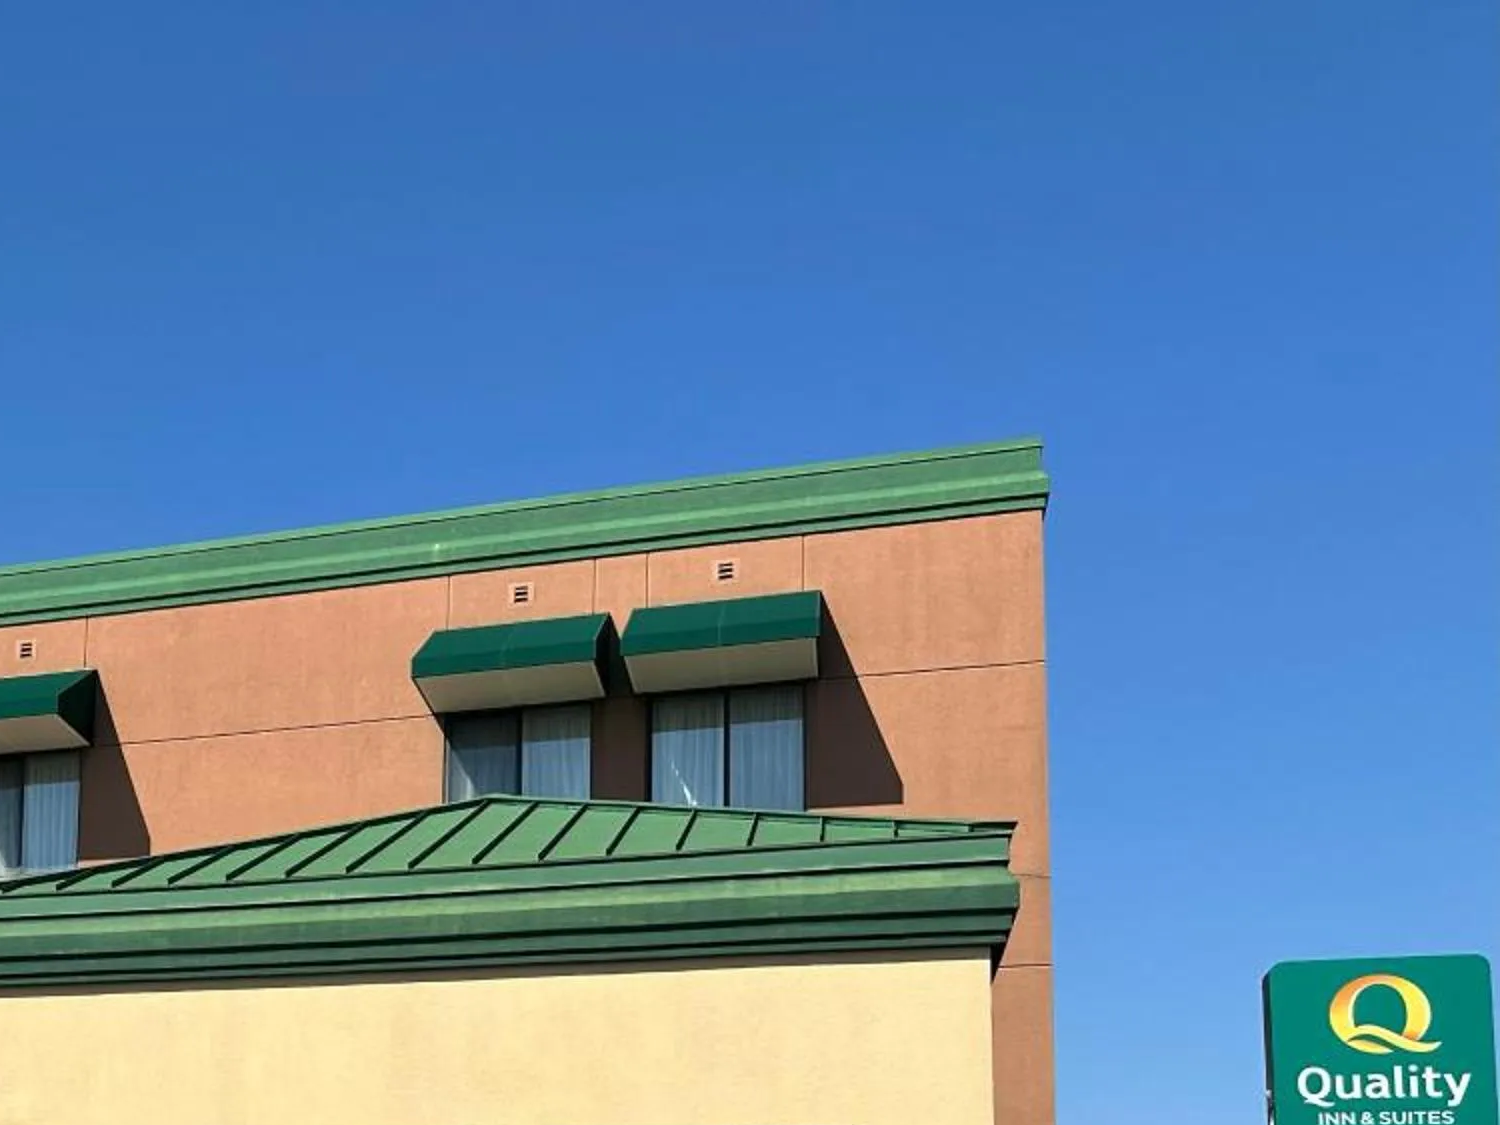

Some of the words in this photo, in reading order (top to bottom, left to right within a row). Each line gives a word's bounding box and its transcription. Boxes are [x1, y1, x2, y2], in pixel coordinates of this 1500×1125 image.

[1329, 974, 1443, 1054] Q
[1297, 1064, 1472, 1107] Quality
[1360, 1111, 1376, 1125] &
[1379, 1110, 1455, 1125] SUITES
